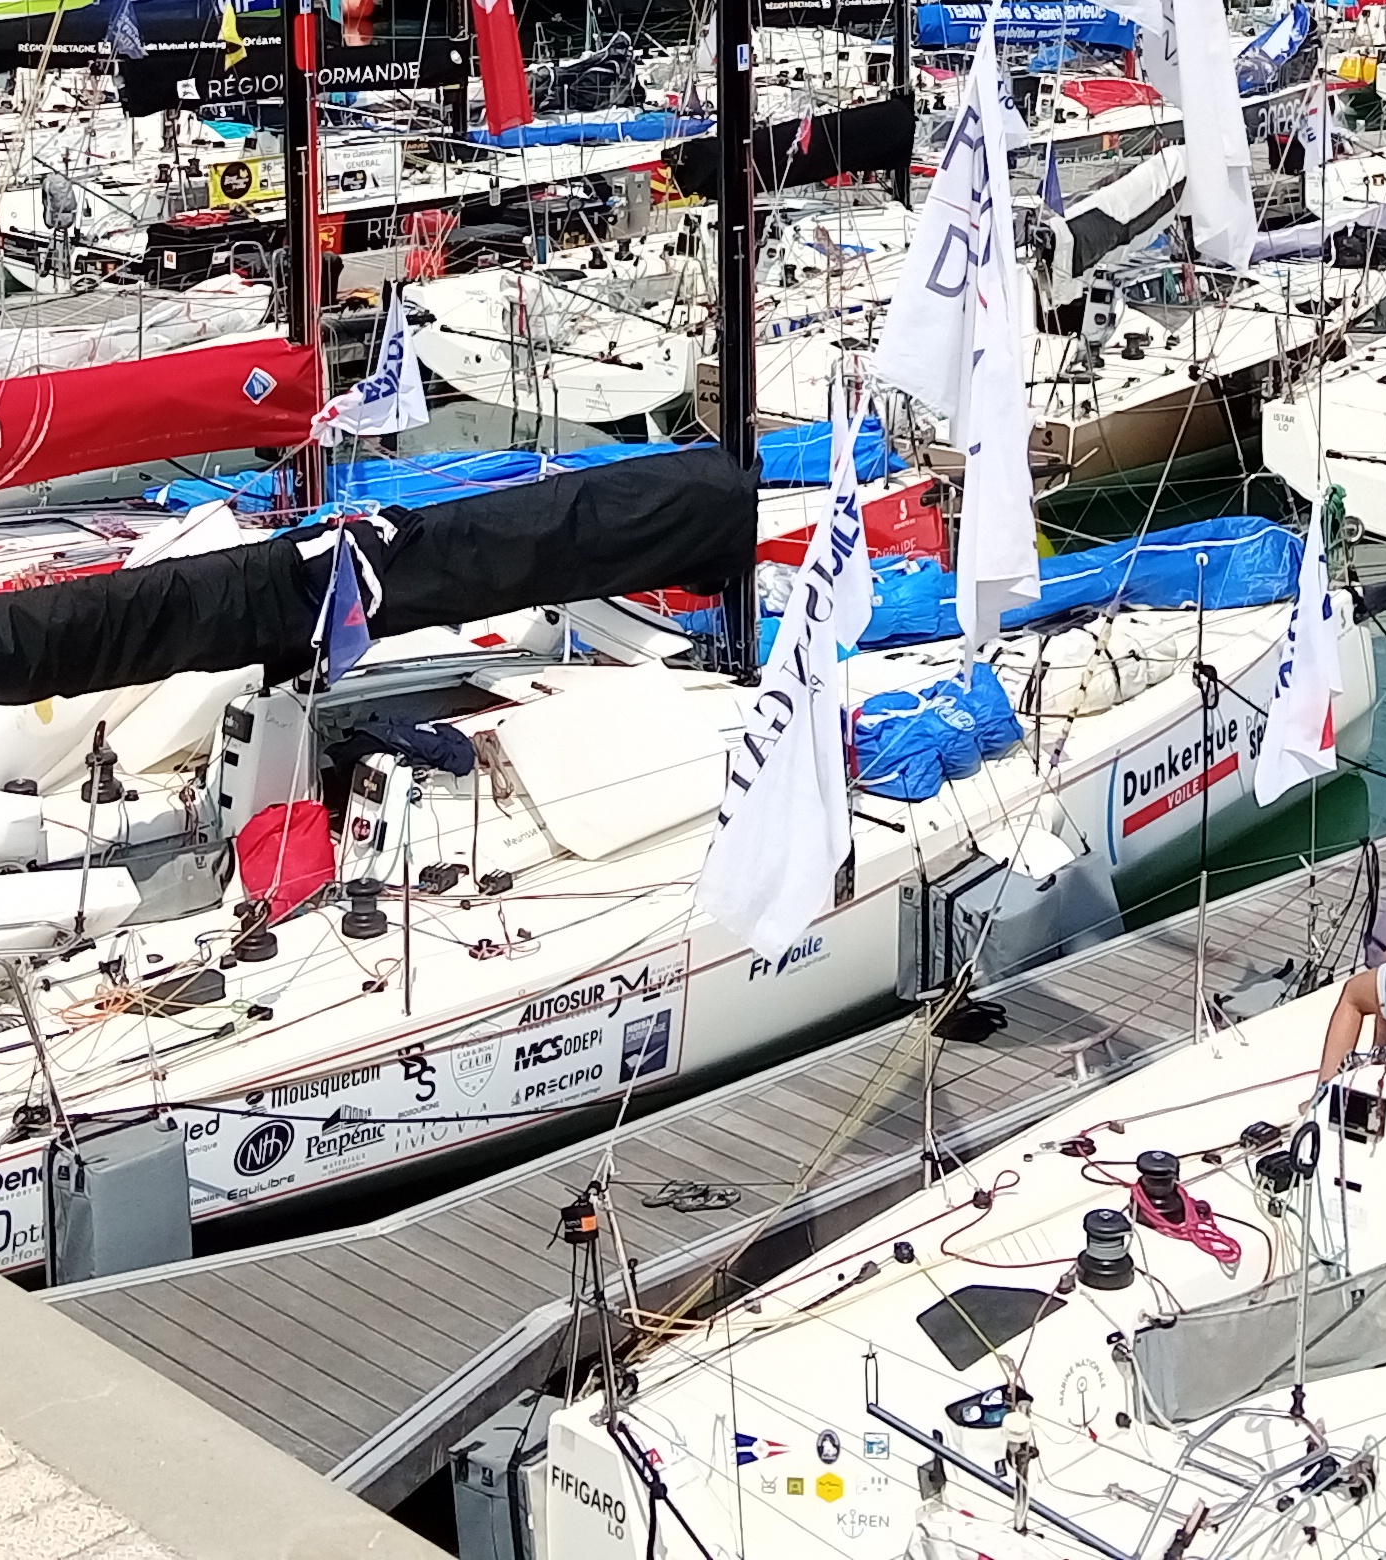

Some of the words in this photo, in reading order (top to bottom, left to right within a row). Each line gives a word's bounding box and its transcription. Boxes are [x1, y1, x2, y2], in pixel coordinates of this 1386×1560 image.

[944, 4, 982, 20] TEAM
[346, 159, 381, 170] GENERAL
[1123, 718, 1239, 806] Dunkerque
[1166, 778, 1200, 809] VOILE
[517, 983, 606, 1027] AUTOSUR
[459, 1054, 493, 1072] CLUB
[271, 1063, 381, 1110] Mousqueton
[524, 1063, 603, 1102] PRECIPIO
[305, 1122, 388, 1162] Penpénic
[550, 1464, 627, 1525] FIFIGARO
[606, 1519, 625, 1541] LO
[836, 1511, 890, 1533] KREN
